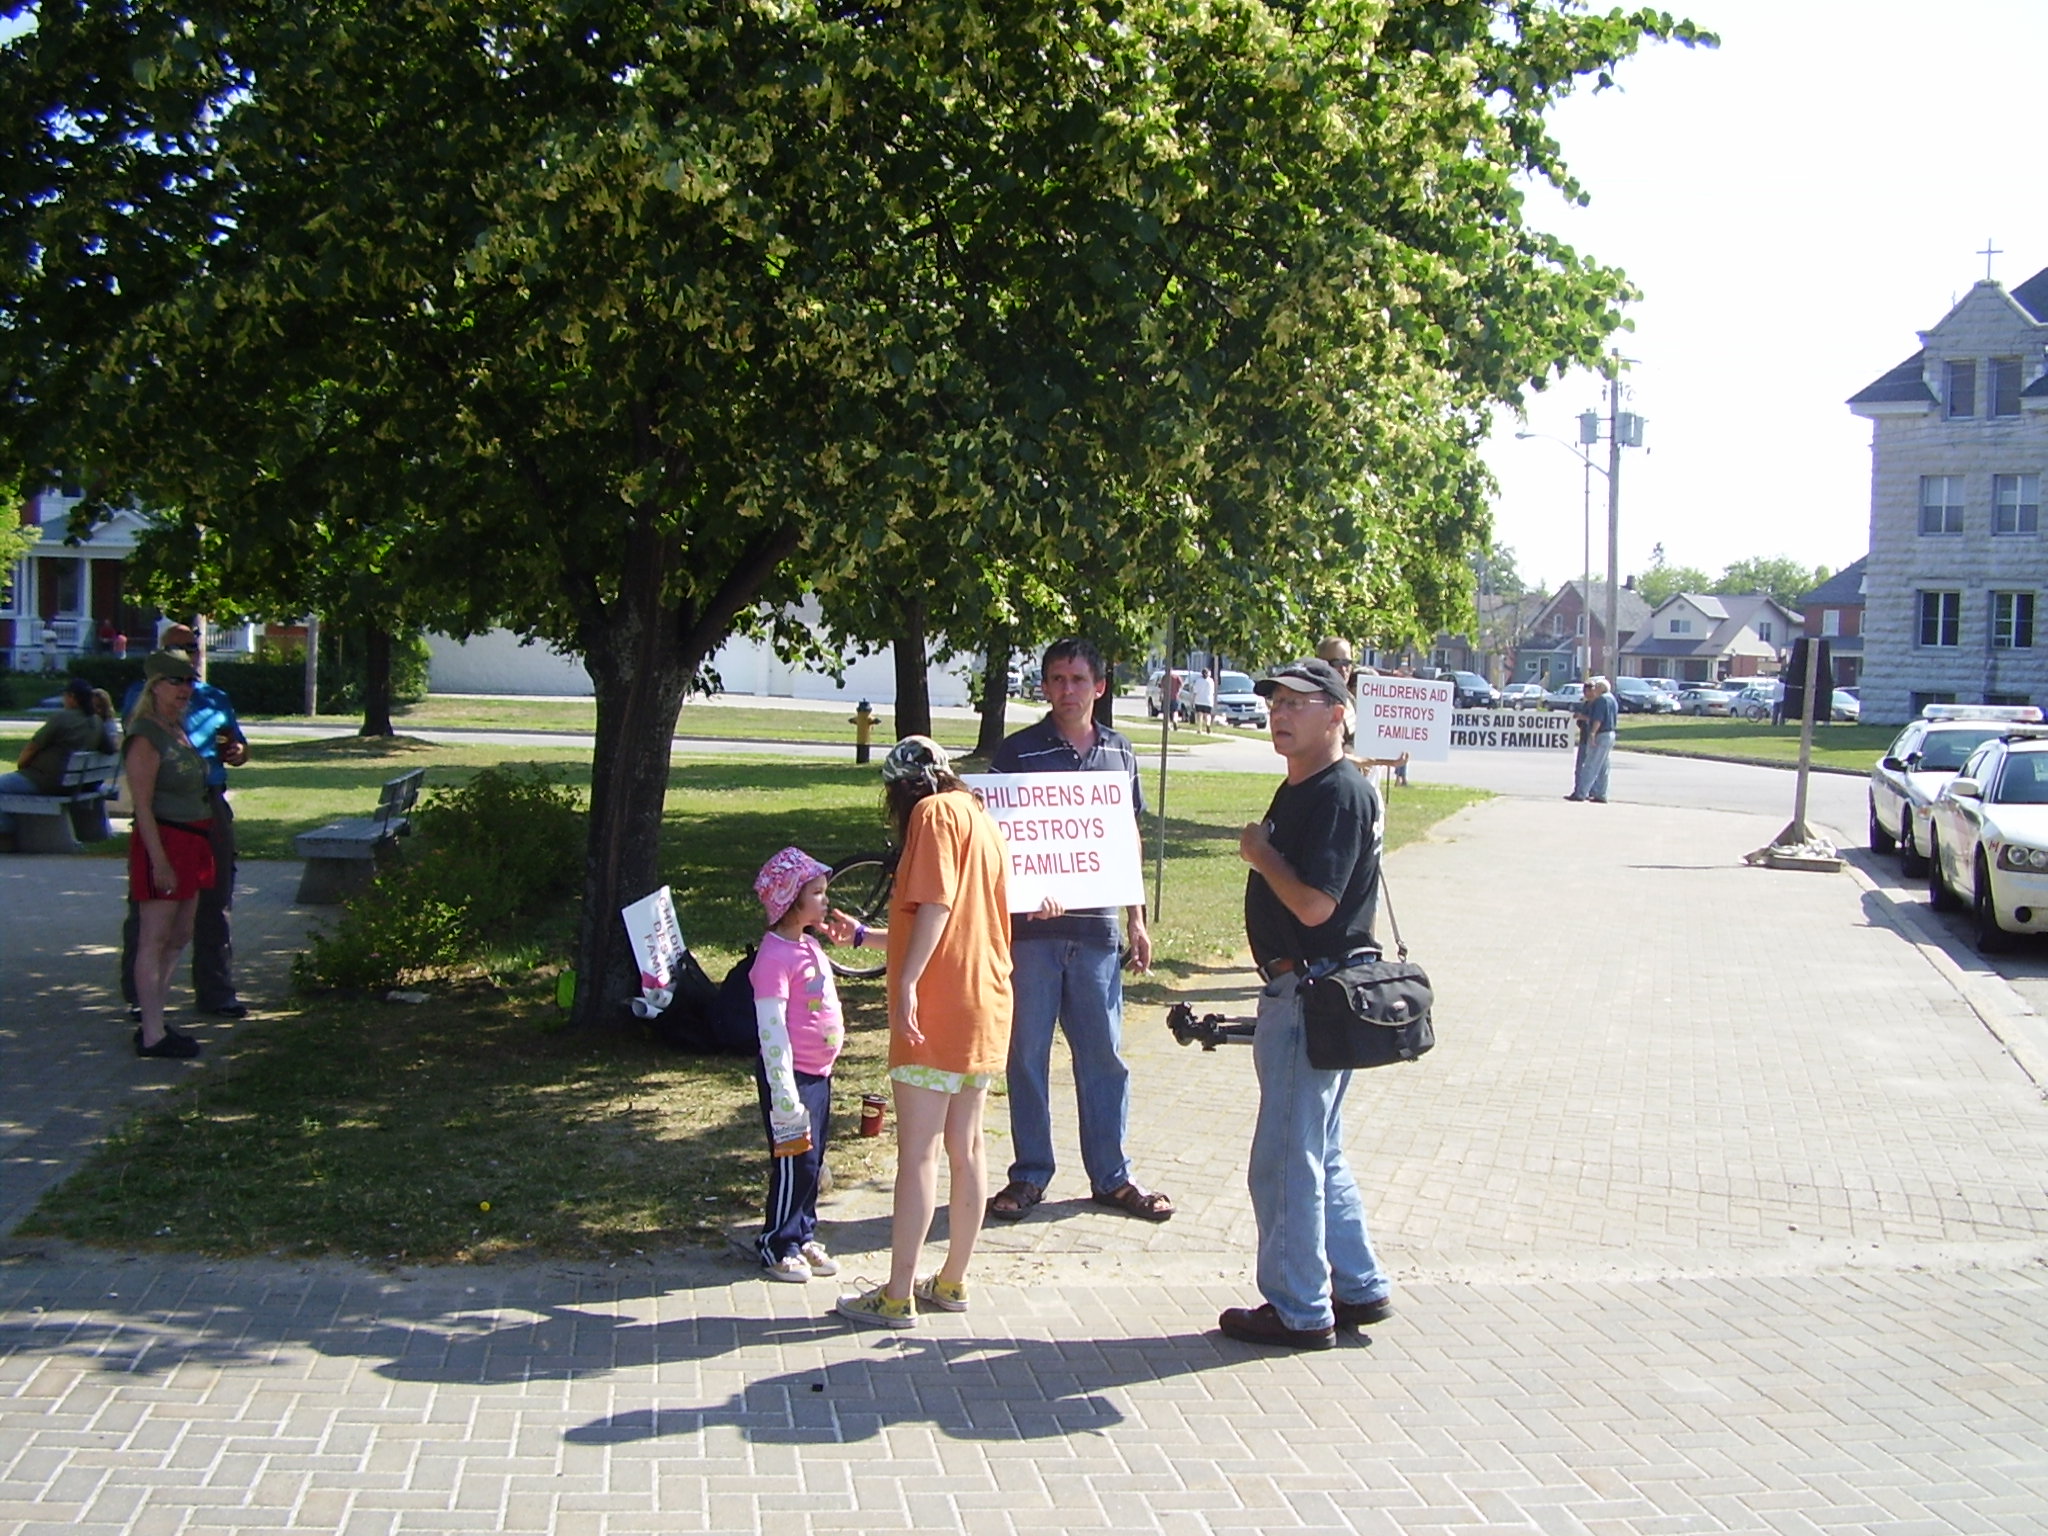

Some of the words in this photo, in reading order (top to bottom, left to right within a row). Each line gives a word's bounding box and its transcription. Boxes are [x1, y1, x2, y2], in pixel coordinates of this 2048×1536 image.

[1362, 682, 1427, 701] CHILDRENS
[1429, 688, 1448, 703] AID
[1374, 704, 1435, 721] DESTROYS
[1493, 715, 1515, 728] AID
[1518, 715, 1571, 730] SOCIETY
[1377, 724, 1428, 741] FAMILIES
[1501, 732, 1569, 749] FAMILIES
[1091, 784, 1121, 806] AID
[999, 817, 1105, 842] DESTROYS
[1012, 851, 1100, 876] FAMILIES
